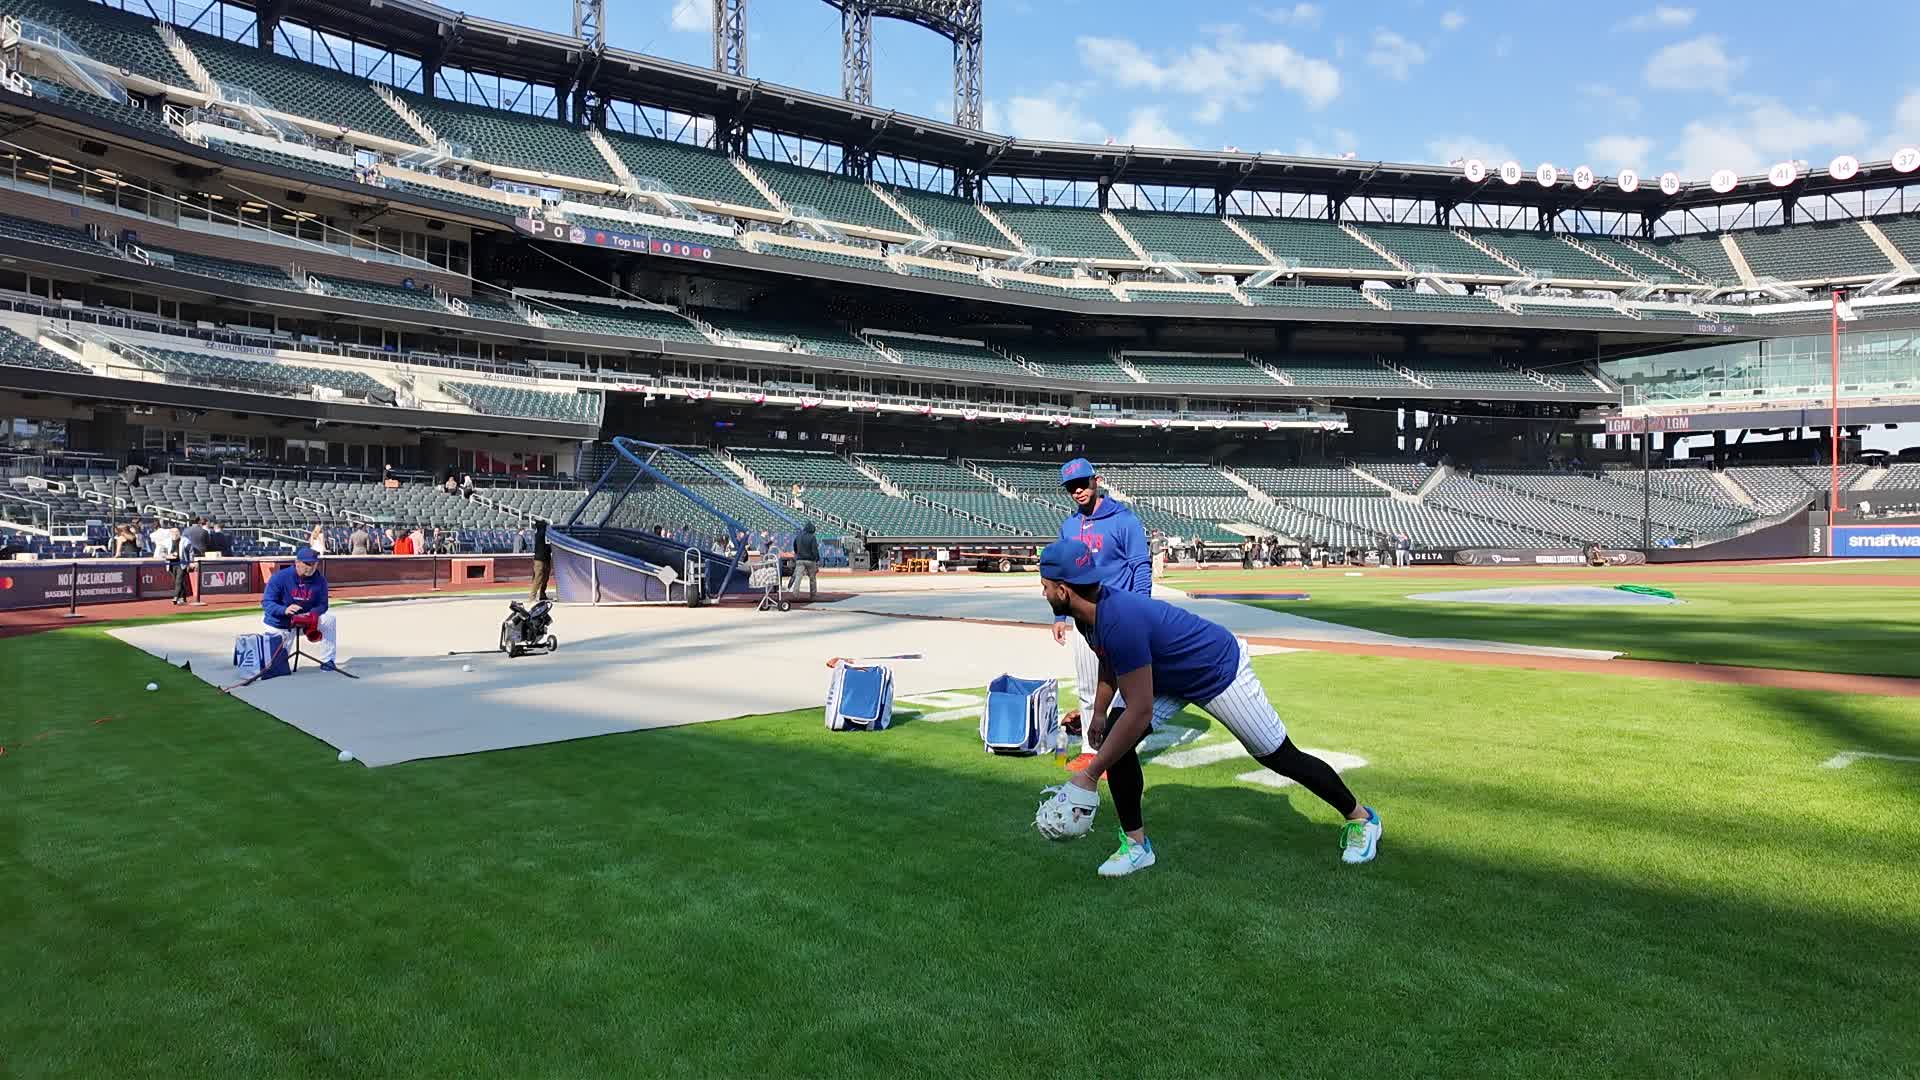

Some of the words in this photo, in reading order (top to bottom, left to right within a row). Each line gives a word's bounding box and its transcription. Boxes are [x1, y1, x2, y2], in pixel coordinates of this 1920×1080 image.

[1898, 154, 1915, 165] 37
[1506, 167, 1516, 177] 18
[1837, 162, 1850, 173] 14
[1542, 170, 1551, 180] 16
[1577, 172, 1589, 182] 24
[1776, 169, 1789, 180] 41
[1623, 175, 1632, 186] 17
[1664, 177, 1675, 188] 36
[1719, 176, 1730, 186] 31
[553, 226, 564, 238] 0
[612, 235, 631, 248] Top
[633, 239, 645, 249] 1st
[662, 242, 671, 253] 0
[681, 245, 690, 256] 0
[703, 249, 711, 259] 0
[218, 343, 255, 353] HYUNDAI
[1608, 419, 1630, 432] LGM
[1667, 417, 1689, 429] LGM
[1848, 533, 1920, 547] smartwa
[58, 573, 69, 586] NO
[70, 573, 91, 585] PACE
[226, 571, 246, 586] APP
